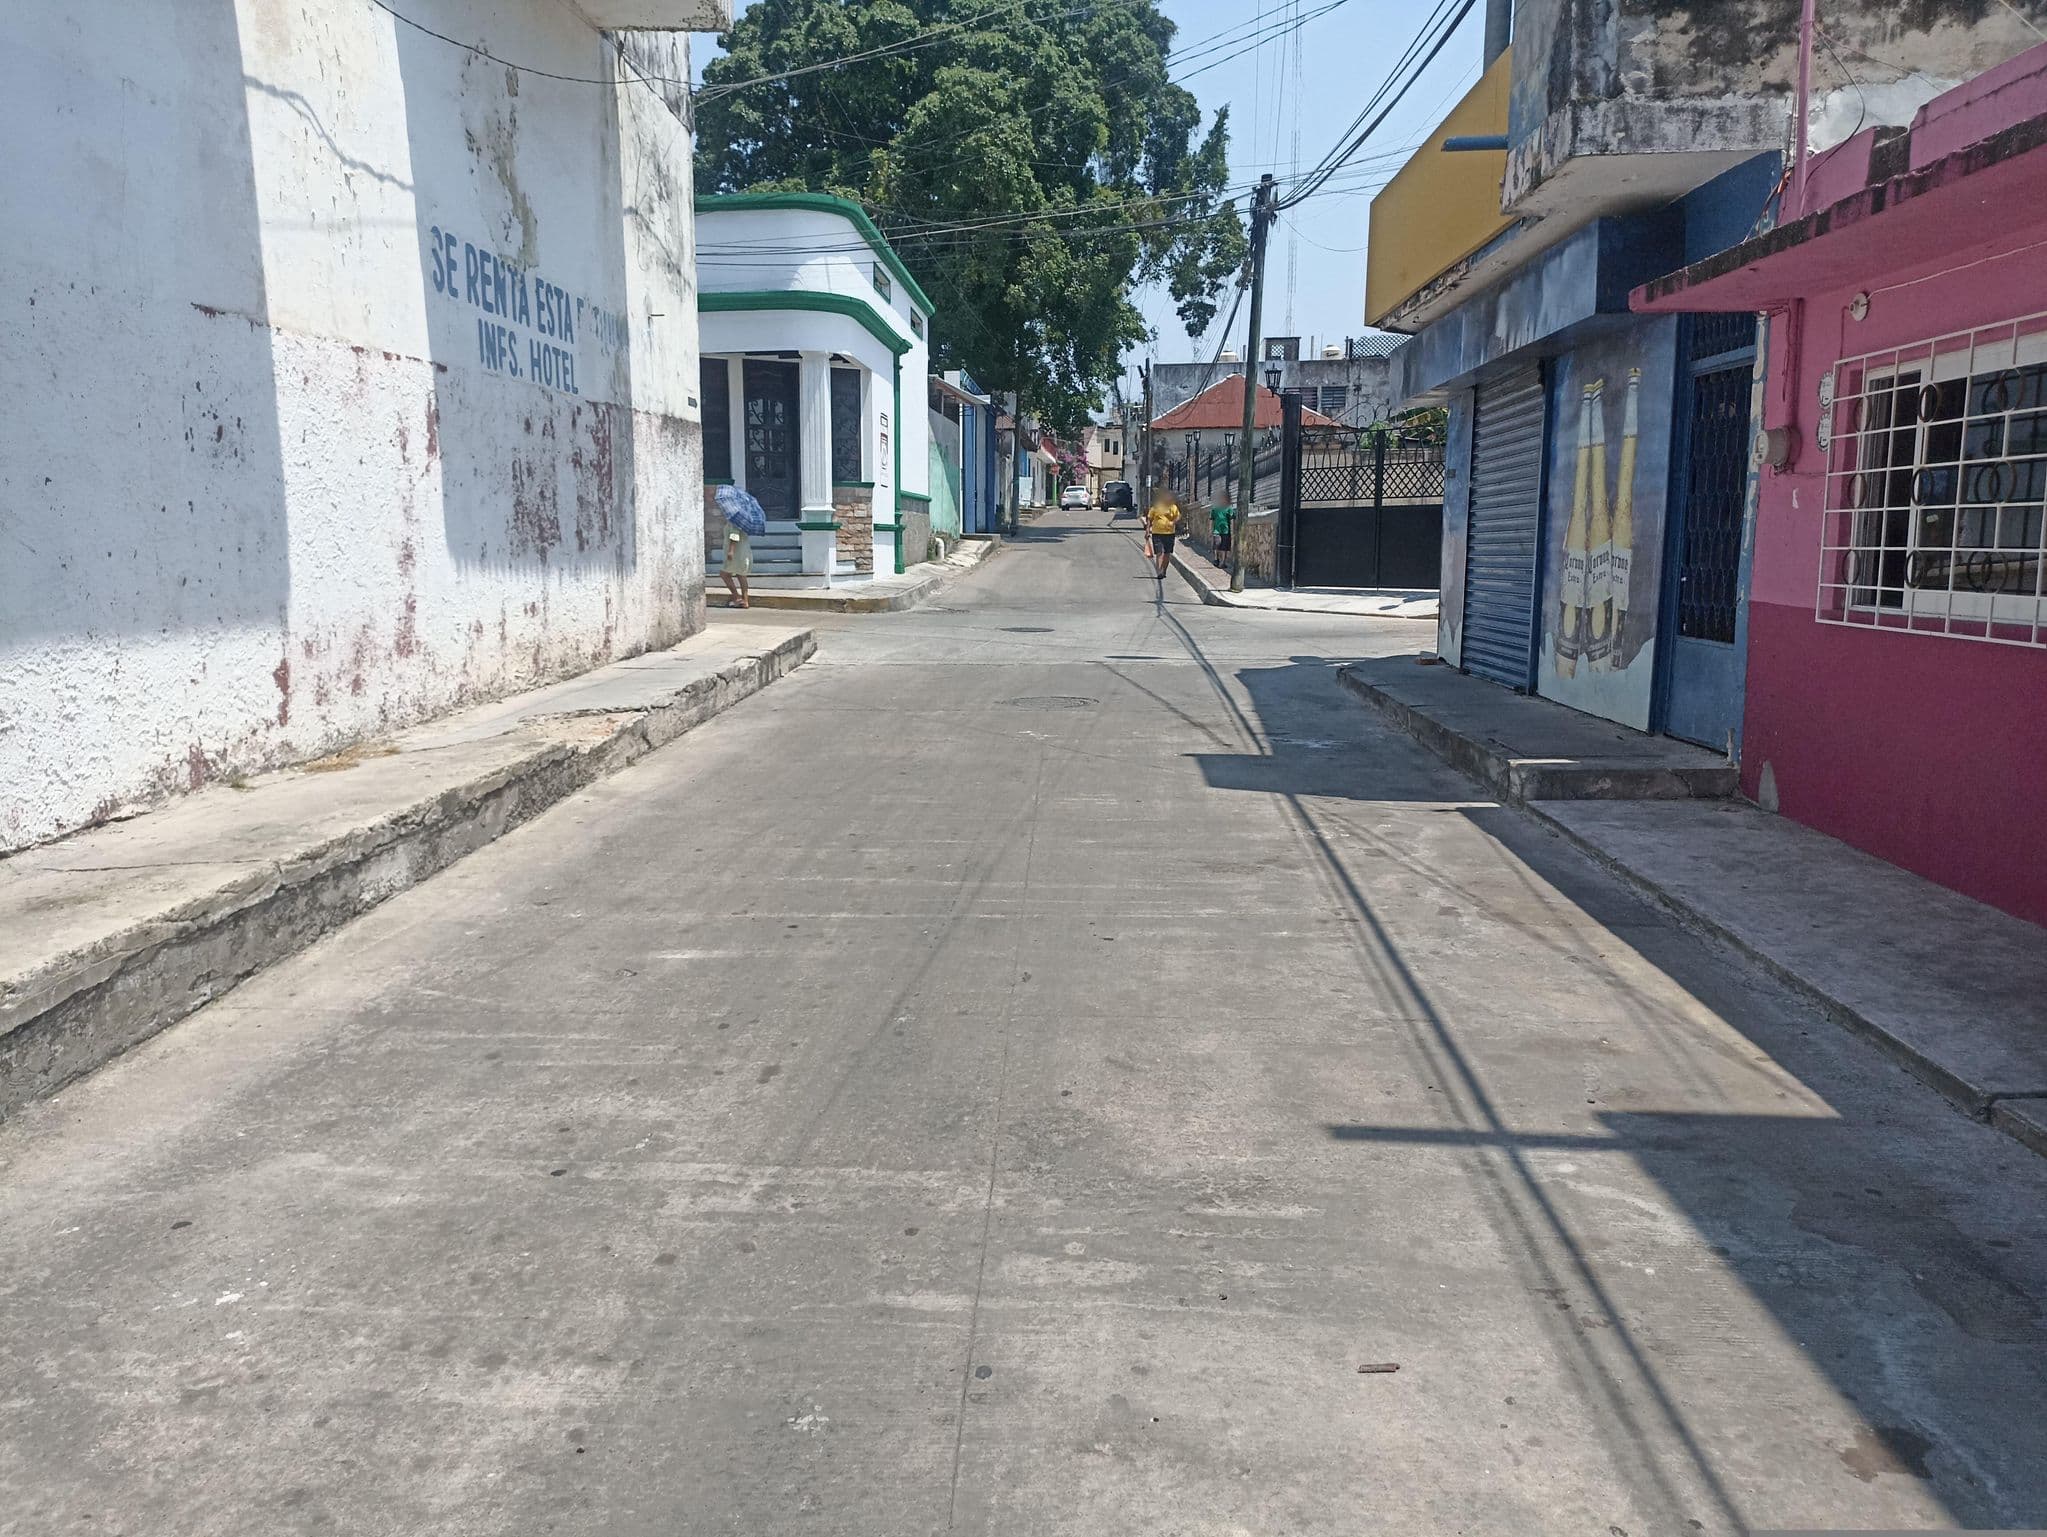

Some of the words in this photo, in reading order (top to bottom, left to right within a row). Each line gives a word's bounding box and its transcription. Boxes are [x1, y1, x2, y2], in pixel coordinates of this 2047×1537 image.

[430, 225, 459, 299] SE
[464, 242, 530, 328] RENTA
[534, 276, 575, 345] ESTA
[477, 317, 524, 378] INFS.
[529, 338, 579, 396] HOTEL
